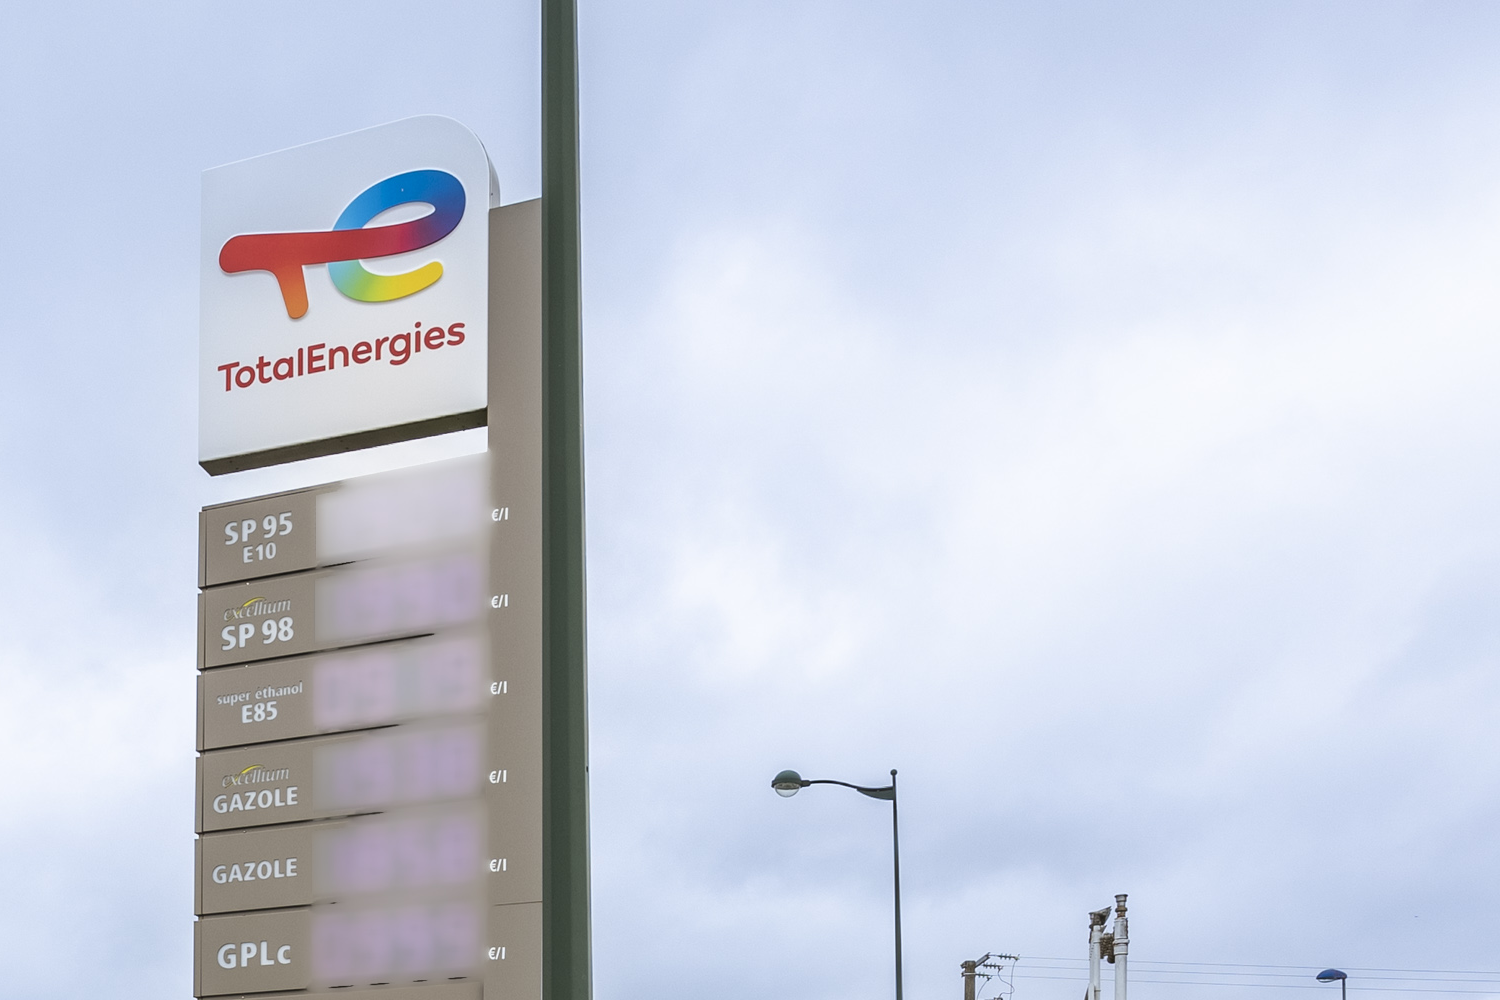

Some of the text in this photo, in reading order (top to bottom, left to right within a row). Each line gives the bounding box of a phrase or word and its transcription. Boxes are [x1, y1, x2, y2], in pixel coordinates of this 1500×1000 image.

[217, 321, 466, 392] TotalEnergies
[224, 512, 294, 546] SP 95
[242, 542, 277, 564] E10
[223, 597, 292, 622] excellium
[220, 616, 295, 651] SP 98
[216, 680, 303, 706] super éthanol
[241, 700, 278, 724] E85
[221, 764, 290, 788] excellium
[212, 786, 299, 815] GAZOLE
[211, 857, 298, 885] GAZOLE
[216, 943, 292, 970] GPLc
